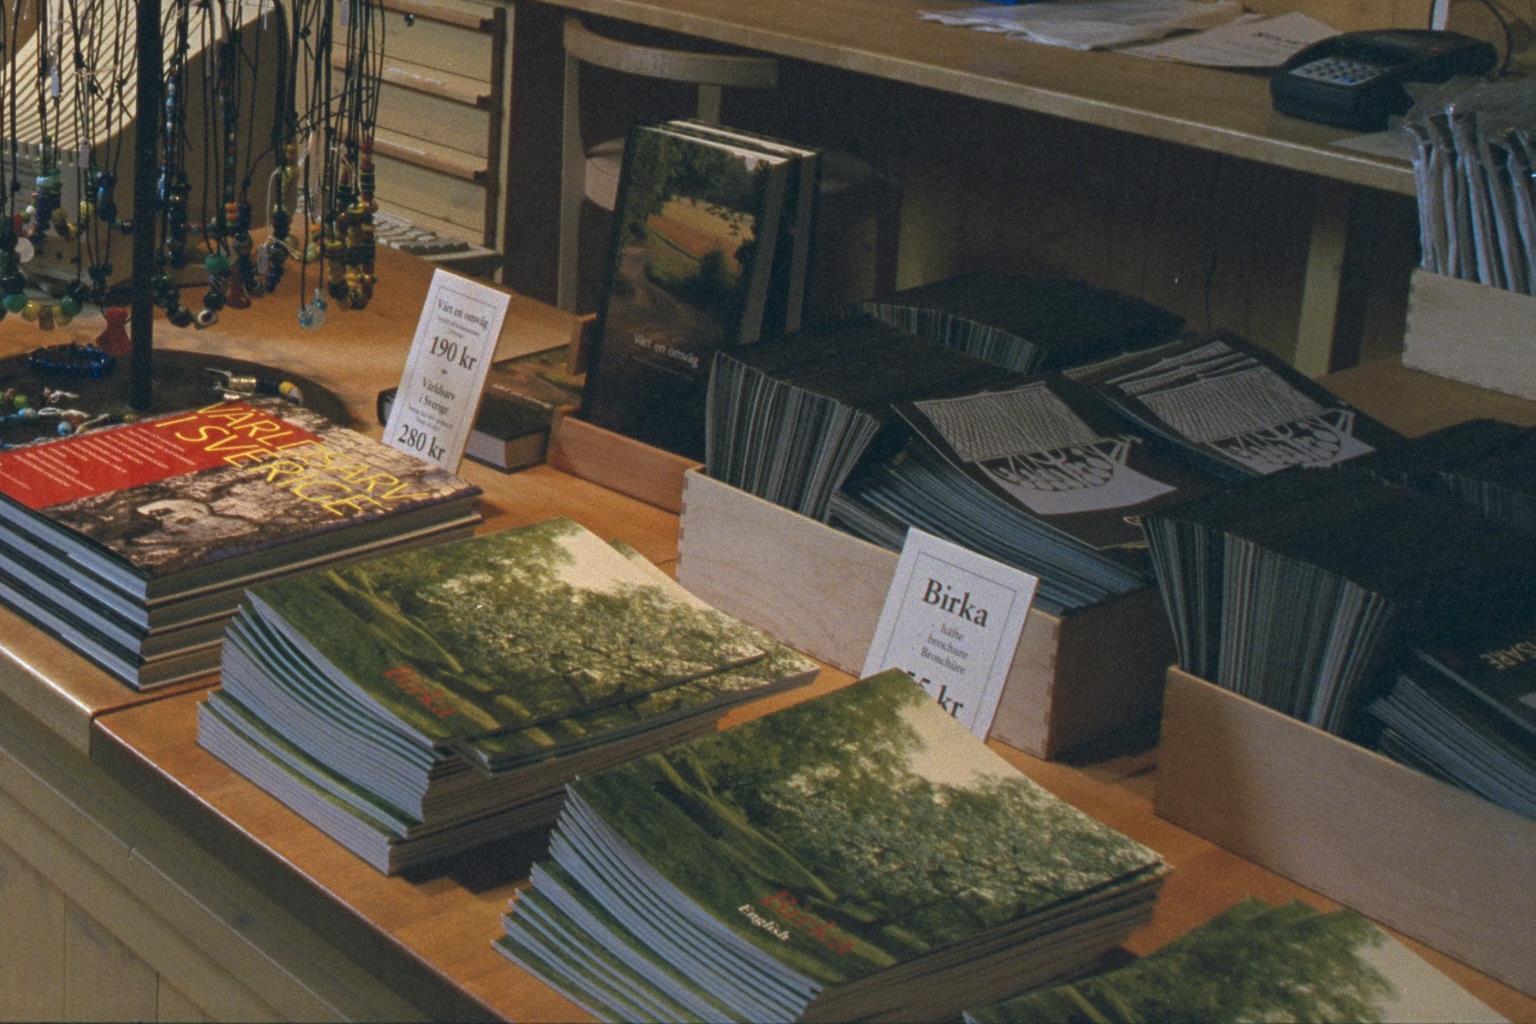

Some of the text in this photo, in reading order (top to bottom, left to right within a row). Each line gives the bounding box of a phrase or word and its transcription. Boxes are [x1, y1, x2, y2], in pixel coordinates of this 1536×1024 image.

[437, 298, 454, 315] Värt
[454, 307, 464, 319] en
[464, 310, 489, 328] omväg
[430, 336, 477, 372] 190 kr
[421, 377, 456, 402] Världsarv
[424, 394, 449, 416] Sverige
[154, 413, 199, 426] I
[197, 402, 432, 500] VÄRLDSARV
[397, 424, 446, 463] 280 kr
[175, 425, 394, 517] SVERIGE
[921, 577, 989, 628] Birka
[927, 632, 969, 660] brochure
[939, 623, 964, 641] häfte
[920, 646, 966, 674] Broschüre
[937, 684, 964, 718] kr
[738, 904, 790, 941] English
[760, 888, 854, 956] Birka
